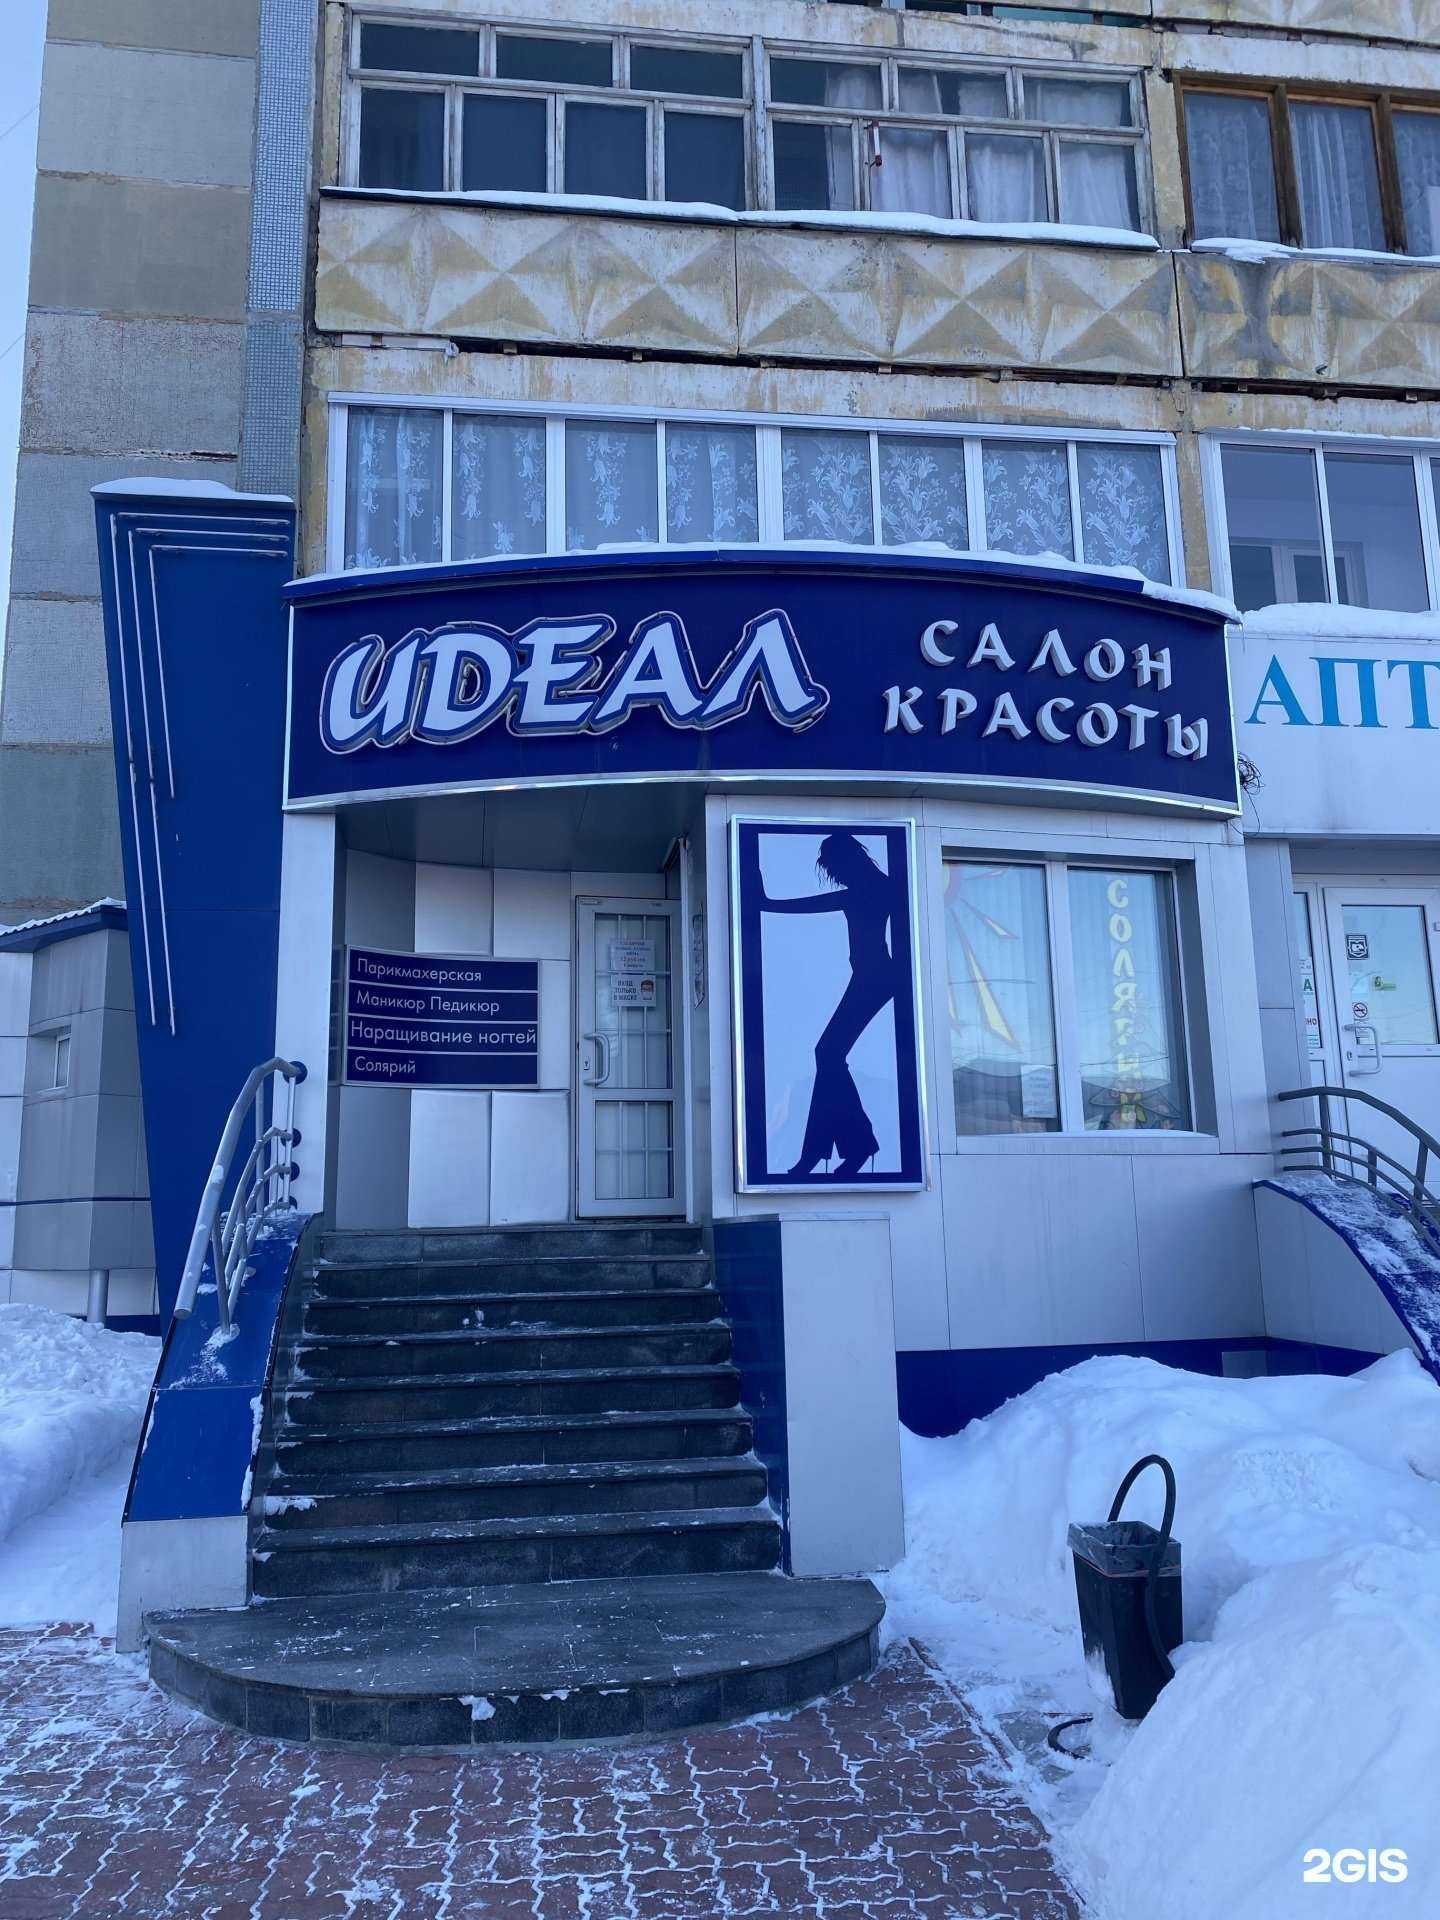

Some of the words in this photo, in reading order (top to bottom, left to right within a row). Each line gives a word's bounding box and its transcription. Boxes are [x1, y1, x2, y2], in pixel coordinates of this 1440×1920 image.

[919, 619, 1173, 692] САЛОН
[322, 611, 828, 750] ИДЕАЛ
[882, 685, 1209, 761] КРАСОТЫ
[357, 958, 482, 984] Парикмахерская
[356, 990, 426, 1014] Маникюр
[430, 996, 500, 1016] Педикюр
[351, 1020, 473, 1044] Наращивание
[478, 1029, 537, 1044] ногтей
[354, 1055, 416, 1077] Солярий
